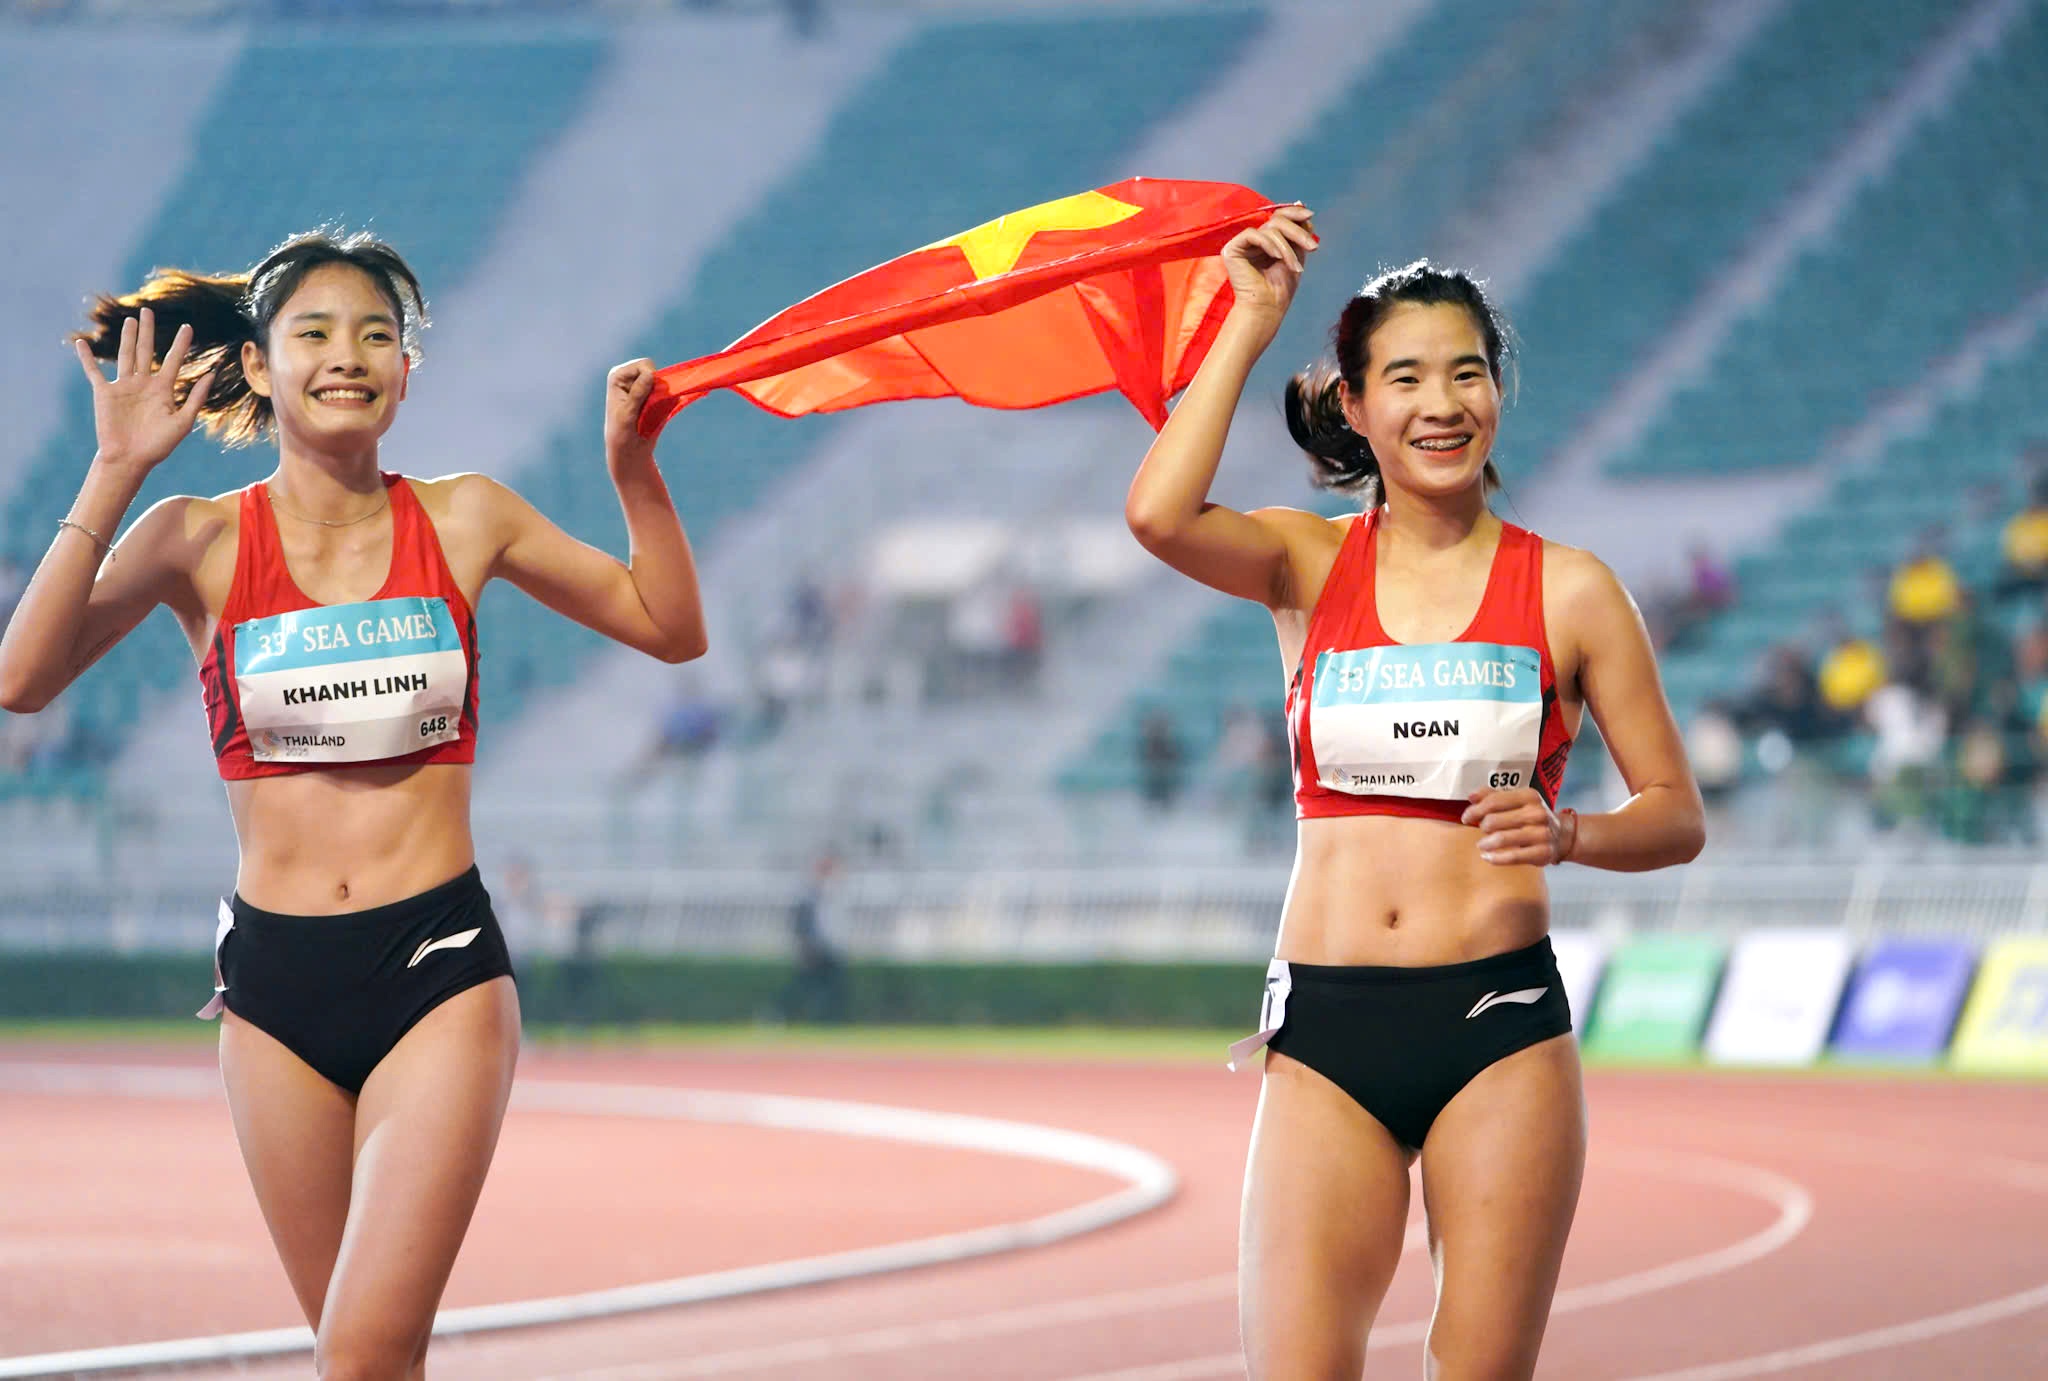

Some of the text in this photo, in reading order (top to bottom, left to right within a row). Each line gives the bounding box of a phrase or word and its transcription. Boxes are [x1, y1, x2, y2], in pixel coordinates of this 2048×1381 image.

[303, 625, 350, 652] SEA
[357, 613, 437, 645] GAMES
[1380, 663, 1425, 689] SEA
[1434, 660, 1516, 688] GAMES
[283, 673, 427, 706] KHANH LINH
[420, 716, 447, 737] 648
[1393, 719, 1459, 739] NGAN
[282, 736, 345, 747] THAILAND
[1351, 774, 1415, 785] THAILAND
[1489, 772, 1520, 787] 630
